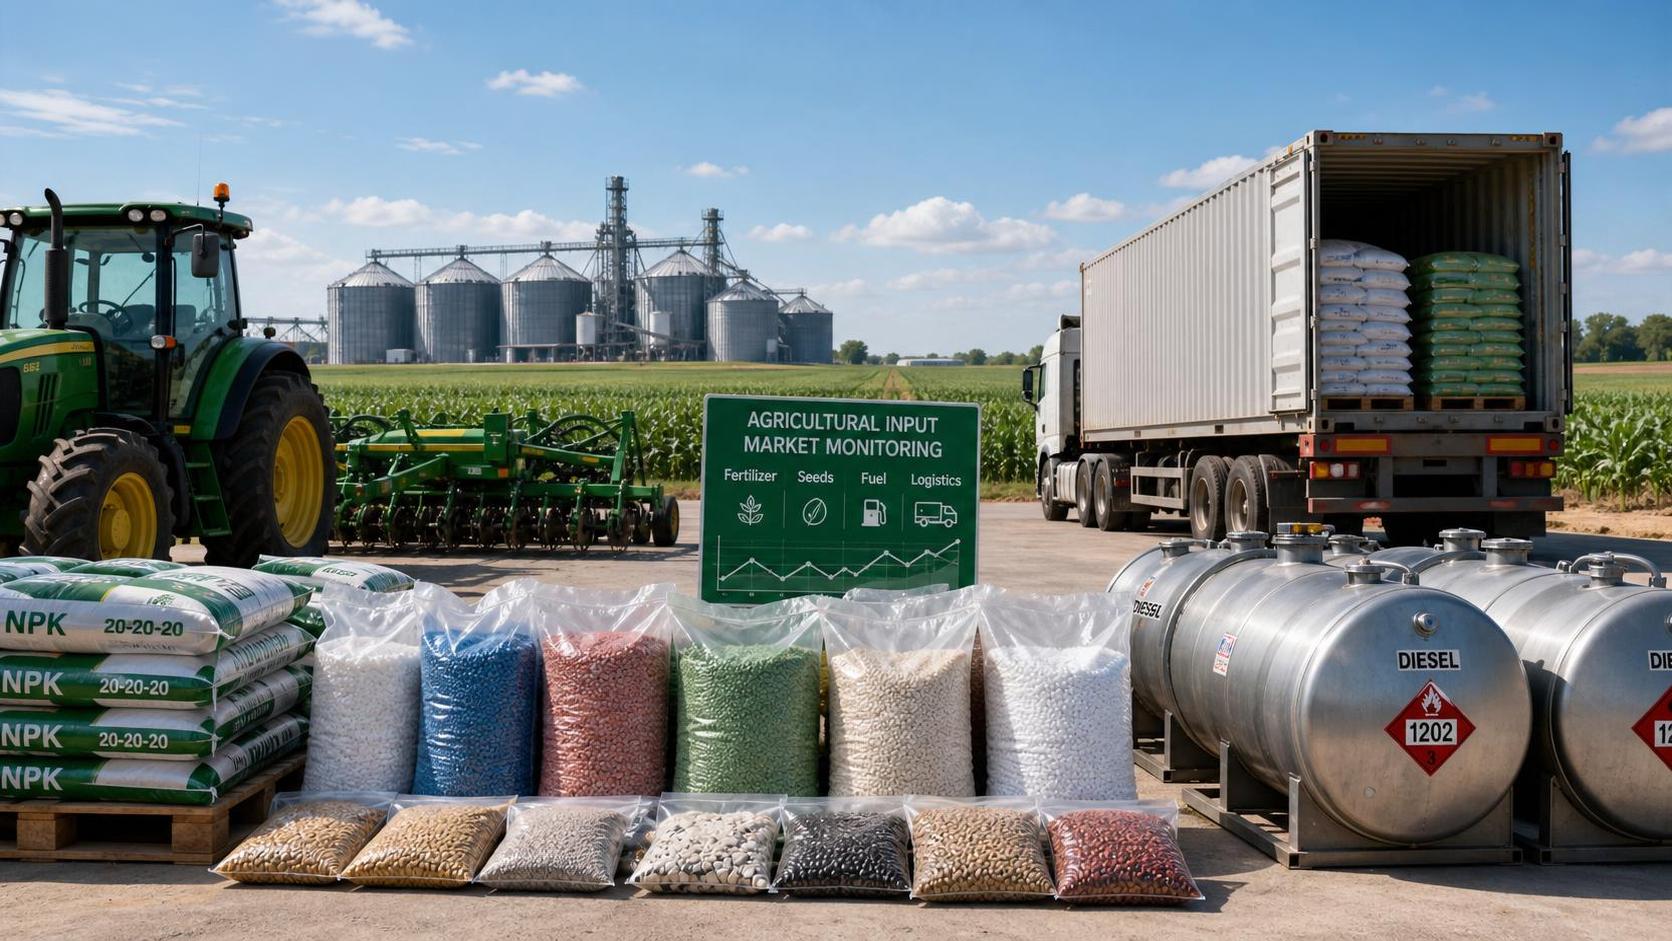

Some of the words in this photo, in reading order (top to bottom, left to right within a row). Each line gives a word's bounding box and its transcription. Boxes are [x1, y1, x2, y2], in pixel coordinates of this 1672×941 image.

[748, 411, 879, 431] AGRICULTURAL
[886, 416, 938, 433] INPUT
[744, 436, 819, 454] MARKET
[826, 439, 942, 457] MONITORING
[724, 468, 777, 482] Fertilizer
[798, 471, 833, 484] Seeds
[862, 473, 886, 485] Fuel
[911, 474, 961, 488] Logistics
[6, 611, 67, 635] NPK
[104, 619, 184, 636] 20-20-20
[1399, 652, 1459, 669] DIESEL
[2, 670, 63, 696] NPK
[100, 679, 169, 695] 20-20-20
[1, 723, 63, 748] NPK
[1409, 722, 1453, 742] 1202
[99, 733, 168, 749] 20-20-20
[1427, 751, 1437, 765] 3
[1, 766, 63, 791] NPK
